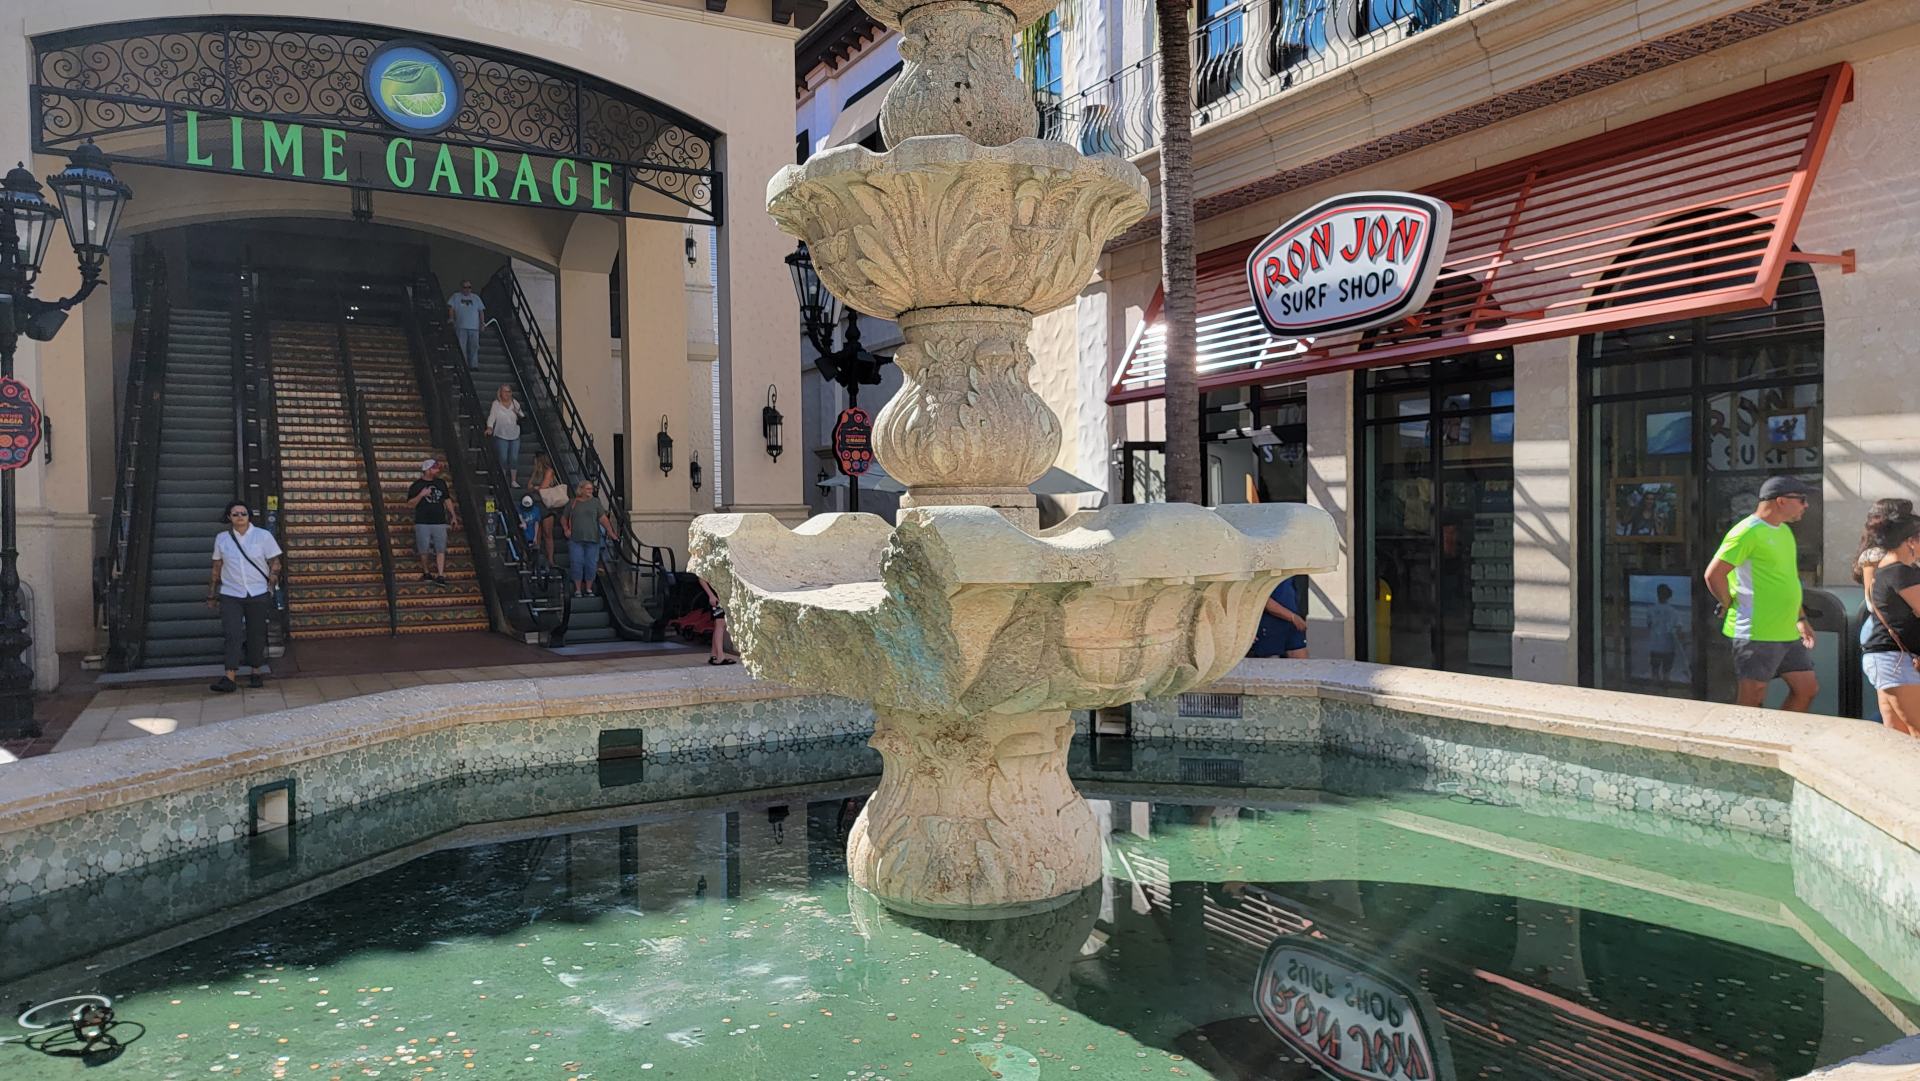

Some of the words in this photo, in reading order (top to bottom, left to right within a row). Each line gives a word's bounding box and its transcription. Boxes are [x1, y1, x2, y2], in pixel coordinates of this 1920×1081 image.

[186, 110, 348, 182] LIME
[385, 137, 614, 211] GARAGE
[1262, 221, 1333, 300] RON
[1339, 213, 1423, 264] JON
[1280, 283, 1328, 316] SURF
[1338, 268, 1396, 303] SHOP
